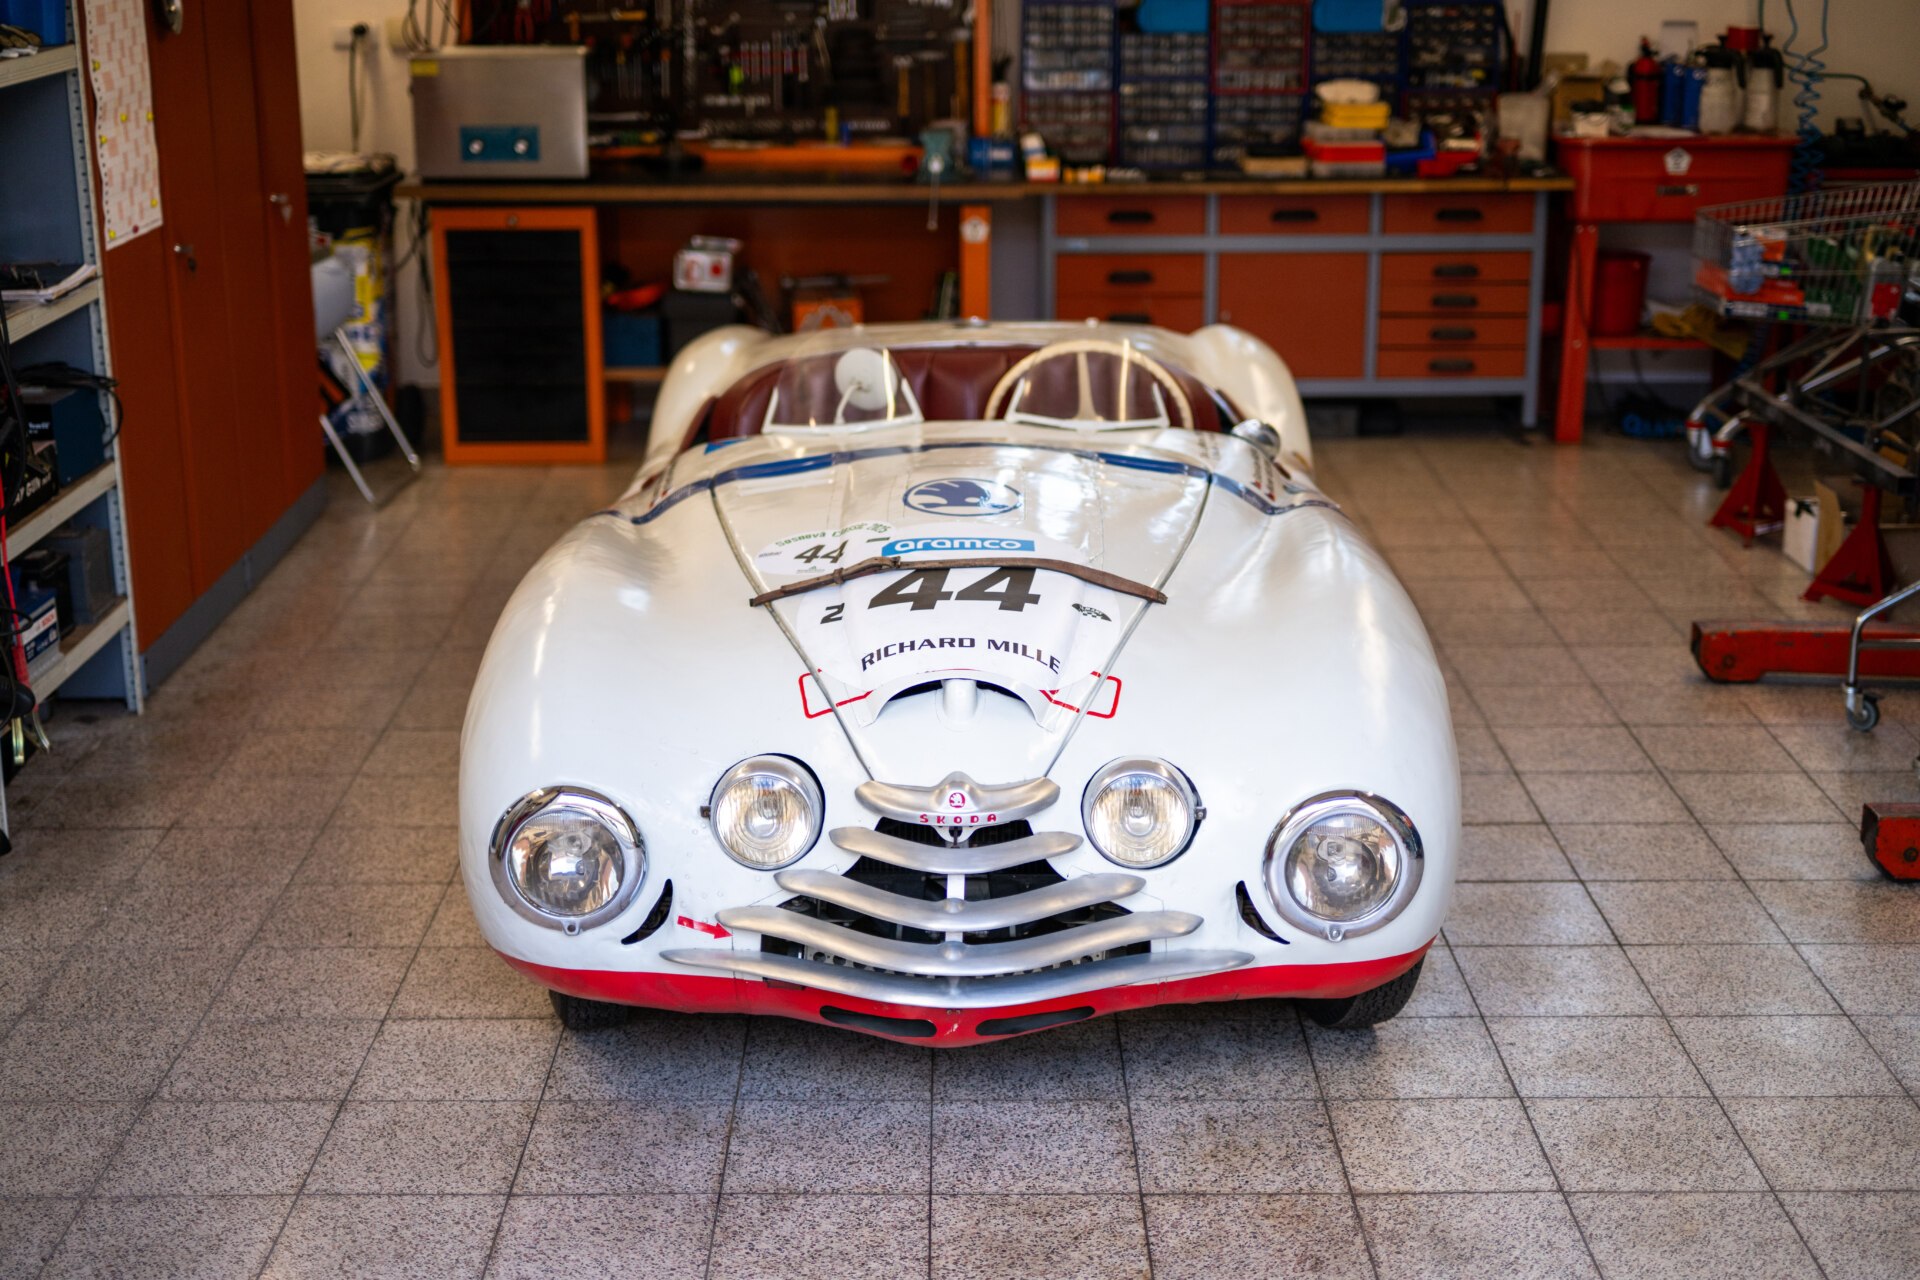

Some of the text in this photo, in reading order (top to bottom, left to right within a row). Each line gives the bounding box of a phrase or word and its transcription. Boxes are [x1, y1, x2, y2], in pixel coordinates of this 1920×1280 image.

[793, 540, 849, 564] 44
[894, 538, 1022, 552] aramco
[867, 567, 1041, 612] 44
[861, 637, 1061, 675] RICHARD MILLE
